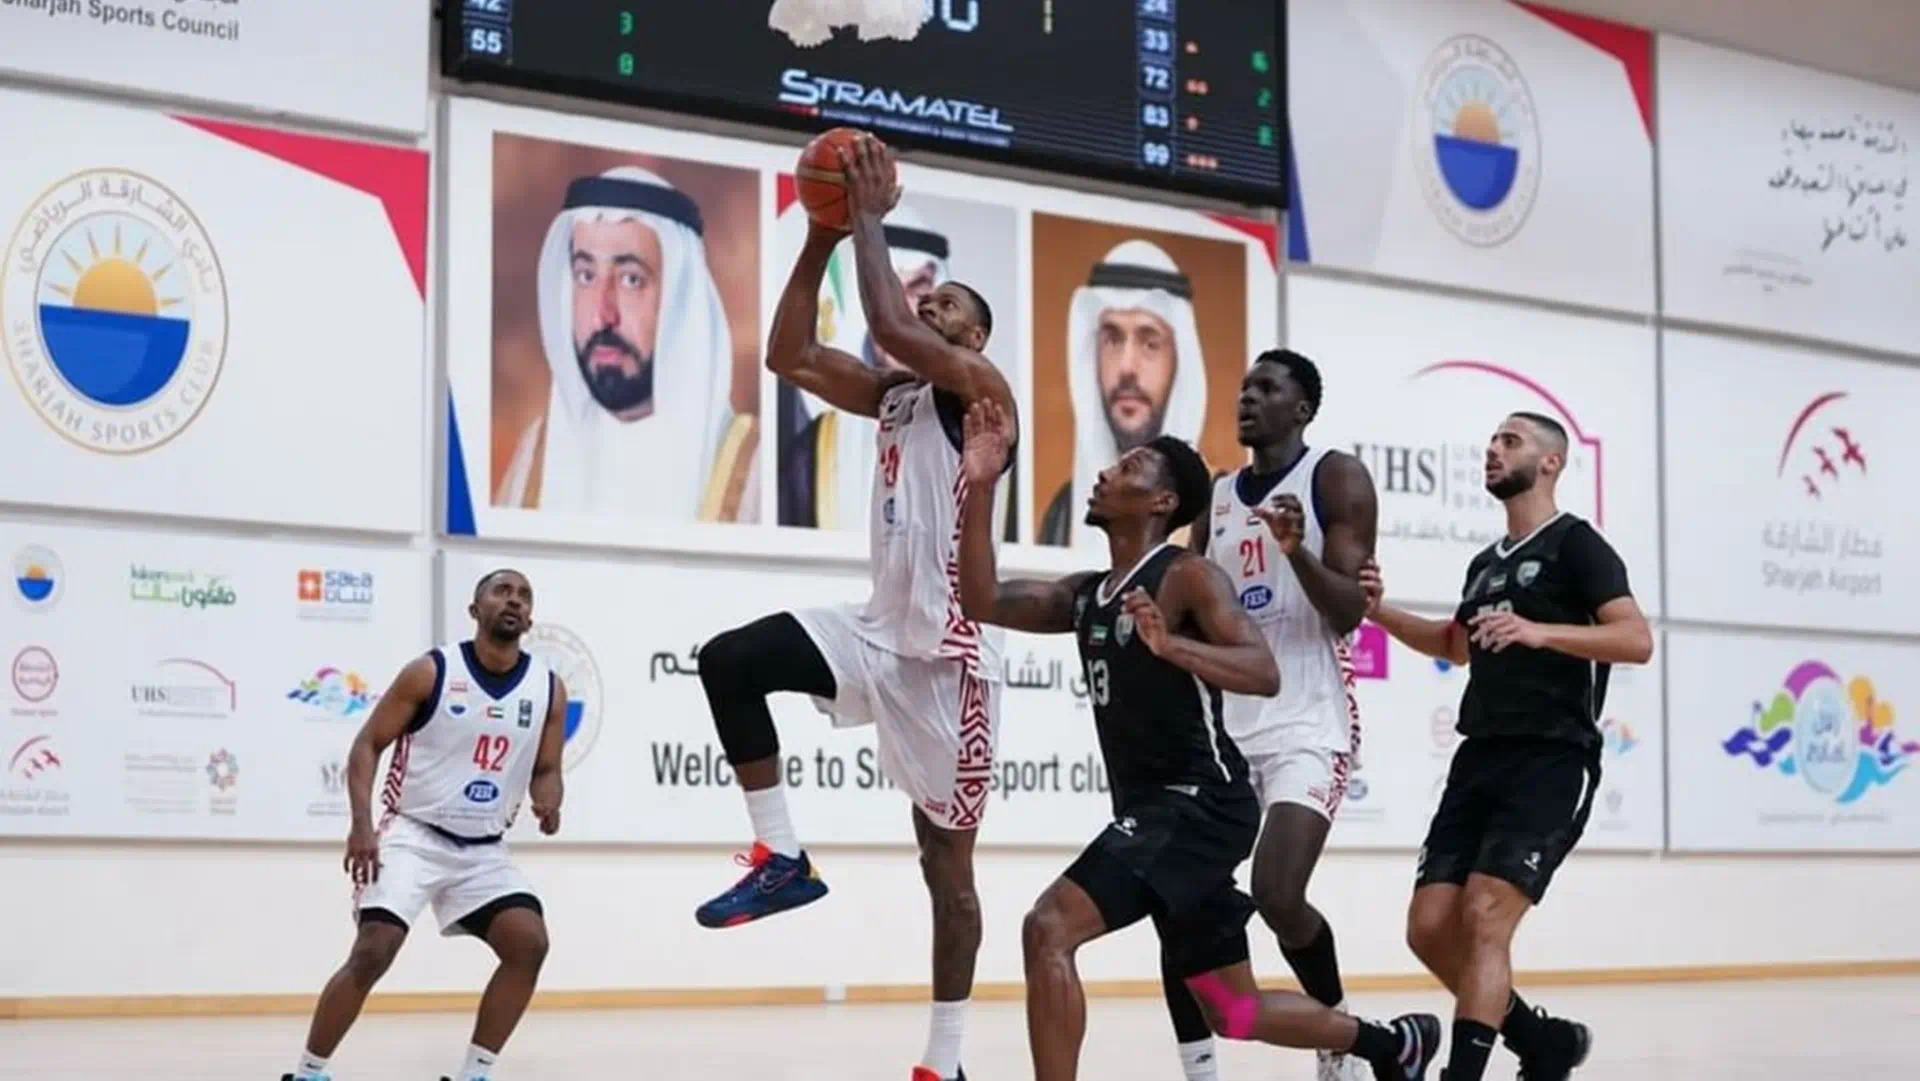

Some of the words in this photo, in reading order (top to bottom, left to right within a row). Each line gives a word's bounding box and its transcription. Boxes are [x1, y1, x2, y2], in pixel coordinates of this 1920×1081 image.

[88, 0, 155, 24] Sports
[162, 9, 239, 40] Council
[619, 11, 633, 36] 3
[1143, 27, 1169, 52] 33
[1143, 65, 1169, 90] 72
[779, 68, 1015, 133] STRAMATEL
[90, 404, 178, 445] SPORTS
[1240, 536, 1265, 577] 21
[473, 734, 510, 772] 42
[651, 742, 803, 788] Welce
[815, 749, 844, 788] to
